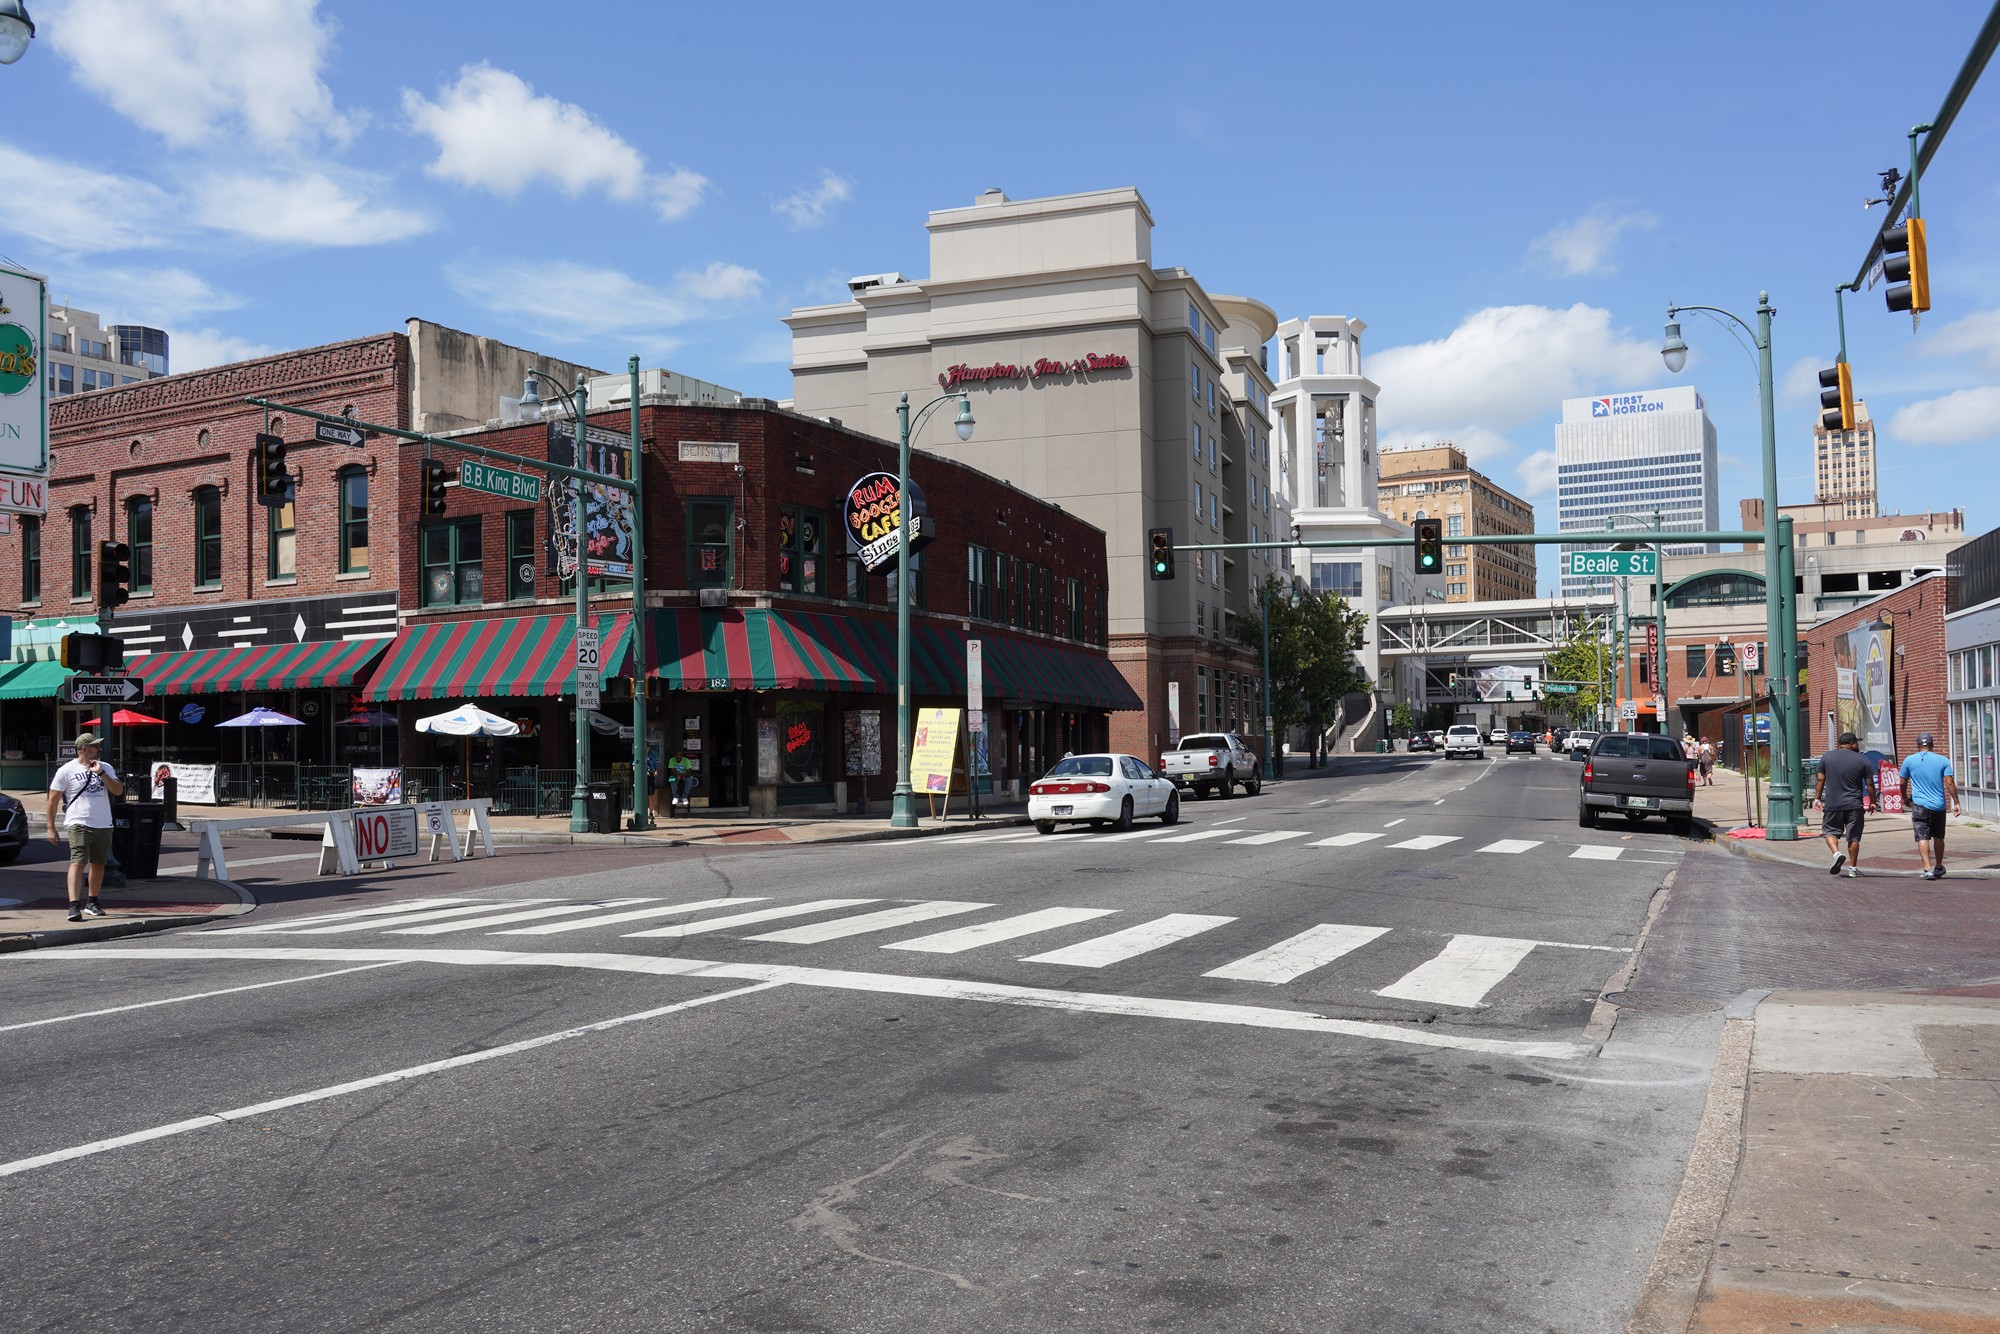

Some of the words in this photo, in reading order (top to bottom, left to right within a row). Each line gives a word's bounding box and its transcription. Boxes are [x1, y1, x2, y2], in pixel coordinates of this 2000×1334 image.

[938, 362, 1022, 388] Hampton
[1025, 357, 1068, 378] Inn
[1080, 352, 1127, 372] Suites
[1613, 395, 1643, 406] FIRST
[1613, 402, 1663, 415] HORIZON
[321, 427, 336, 438] ONE
[337, 431, 351, 440] WAY
[464, 464, 485, 487] B.B.
[486, 469, 509, 495] King
[512, 475, 538, 499] Blvd.
[852, 476, 896, 509] RUM
[861, 509, 901, 541] CAFE
[861, 534, 899, 561] Since
[1573, 555, 1619, 573] Beale
[1629, 554, 1654, 573] St.
[578, 631, 598, 640] SPEED
[580, 640, 596, 648] LIMIT
[579, 649, 598, 664] 20
[1649, 627, 1659, 692] HOOTERS
[81, 684, 102, 695] ONE
[104, 685, 124, 694] WAY
[578, 681, 599, 689] TRUCKS
[711, 678, 727, 688] 182
[1623, 709, 1636, 717] 25
[358, 815, 389, 857] NO
